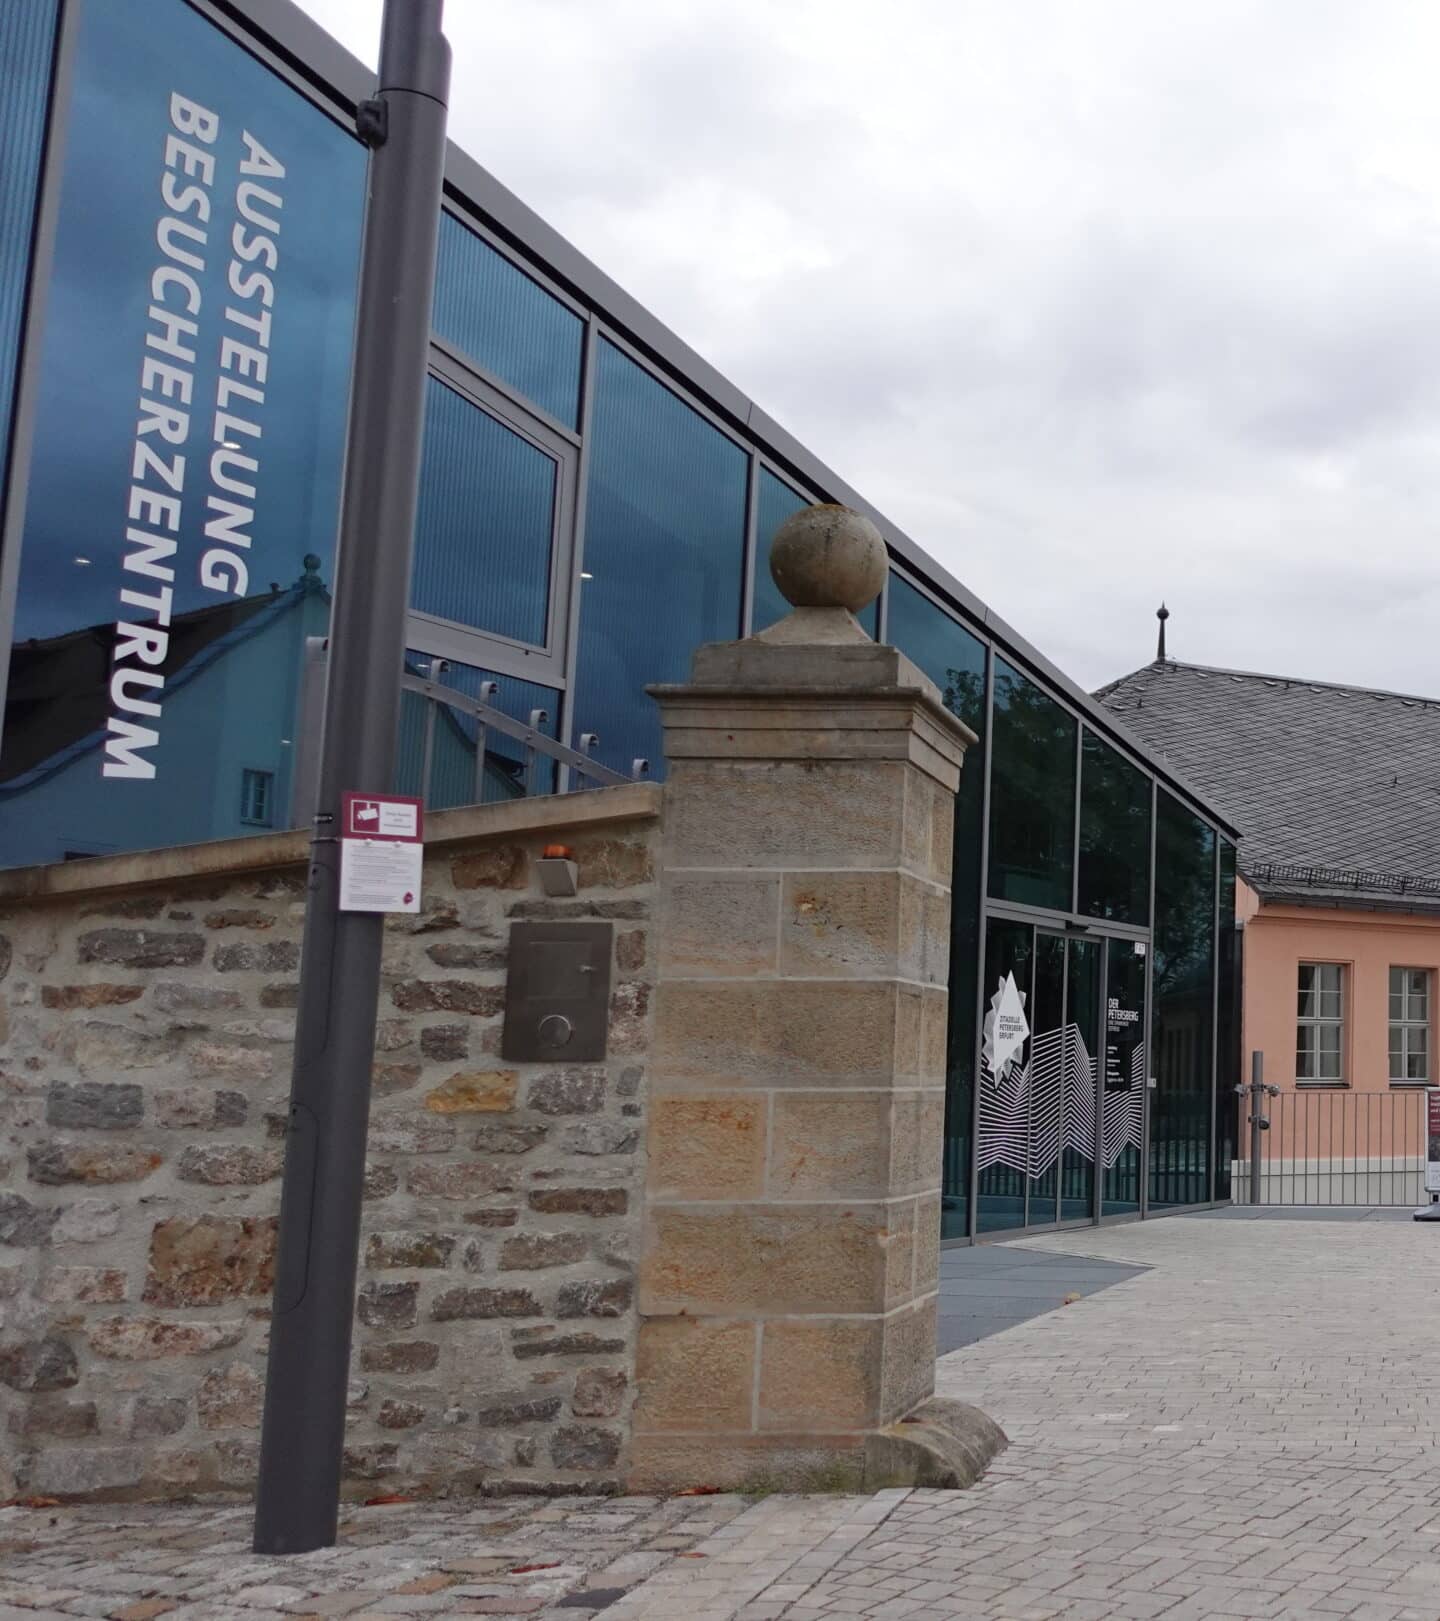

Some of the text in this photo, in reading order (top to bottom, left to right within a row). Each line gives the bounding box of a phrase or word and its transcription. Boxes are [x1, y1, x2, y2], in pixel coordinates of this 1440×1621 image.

[102, 91, 220, 780] BESUCHERZENTRUM
[200, 130, 286, 598] AUSSTELLUNG
[1107, 1008, 1139, 1022] PETERSBERG
